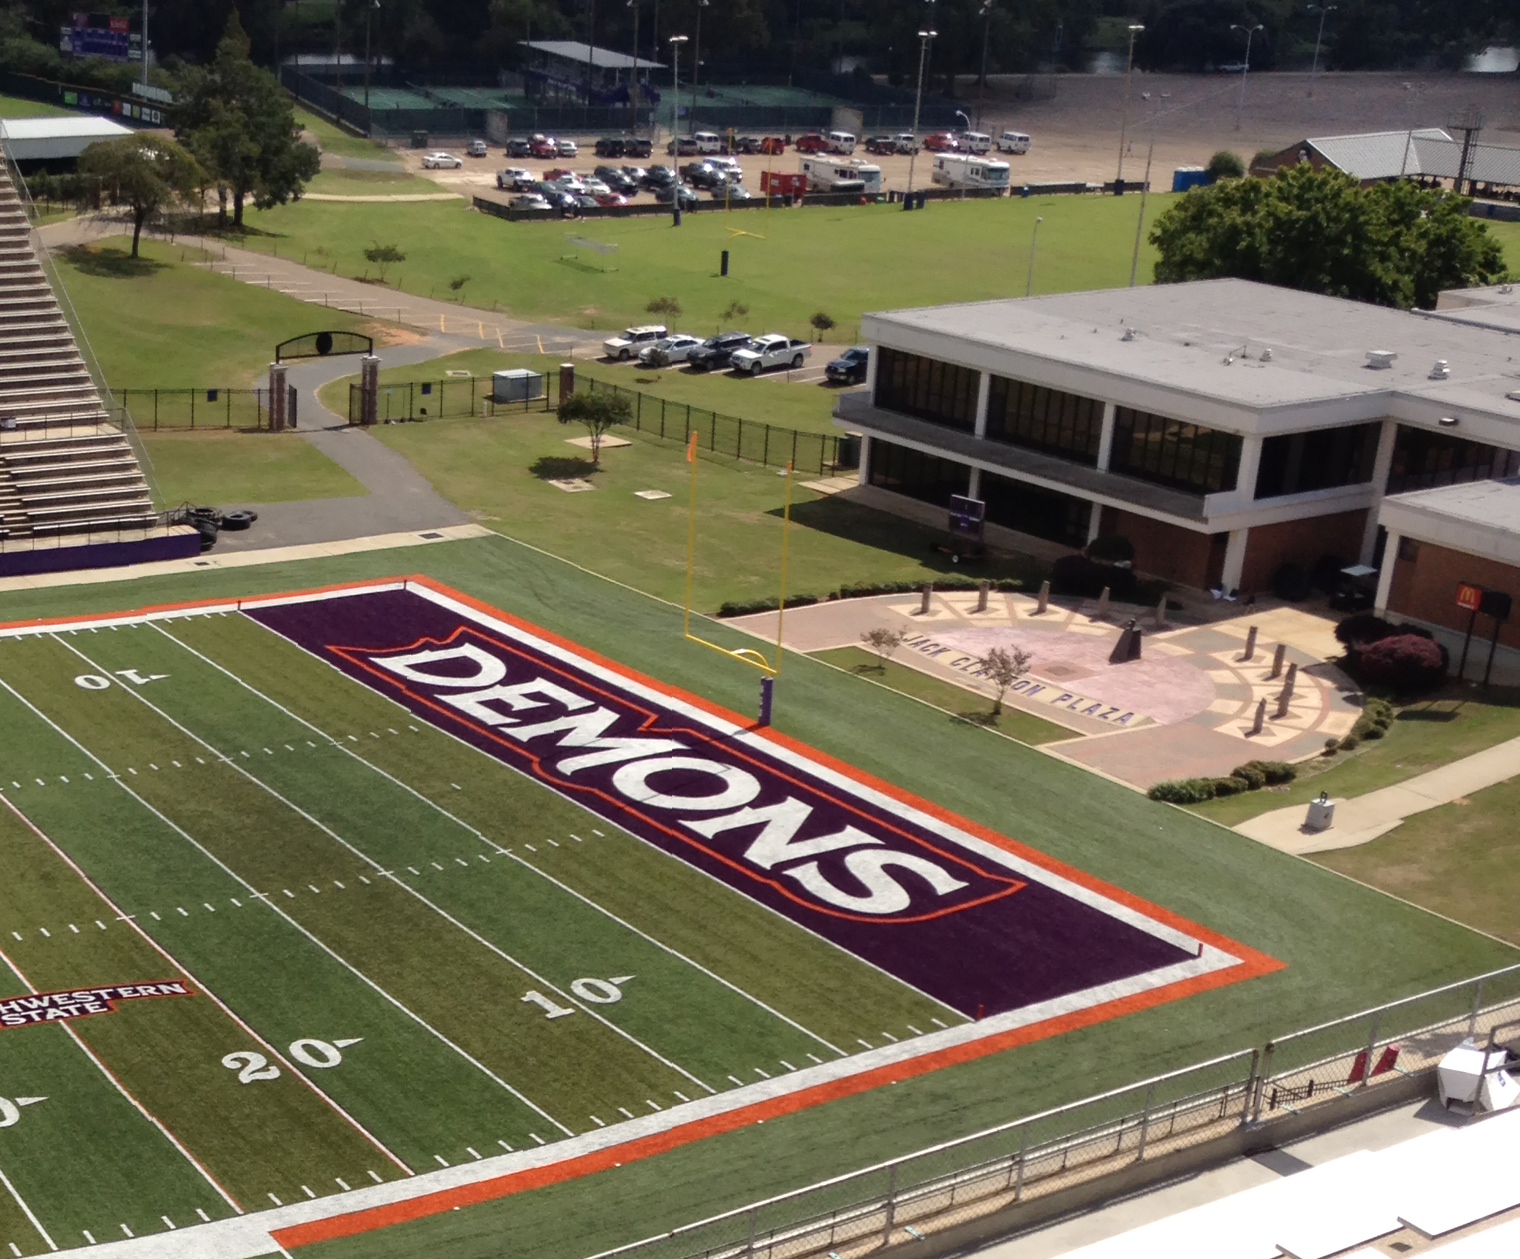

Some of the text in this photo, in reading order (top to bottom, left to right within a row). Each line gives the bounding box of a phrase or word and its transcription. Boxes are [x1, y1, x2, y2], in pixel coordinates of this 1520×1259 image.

[73, 668, 160, 691] 10
[903, 632, 1136, 726] JACK CLAON PLAZA
[369, 643, 969, 914] DEMONS
[1, 1001, 109, 1026] STATE
[520, 977, 625, 1020] 10
[221, 1038, 346, 1085] 20
